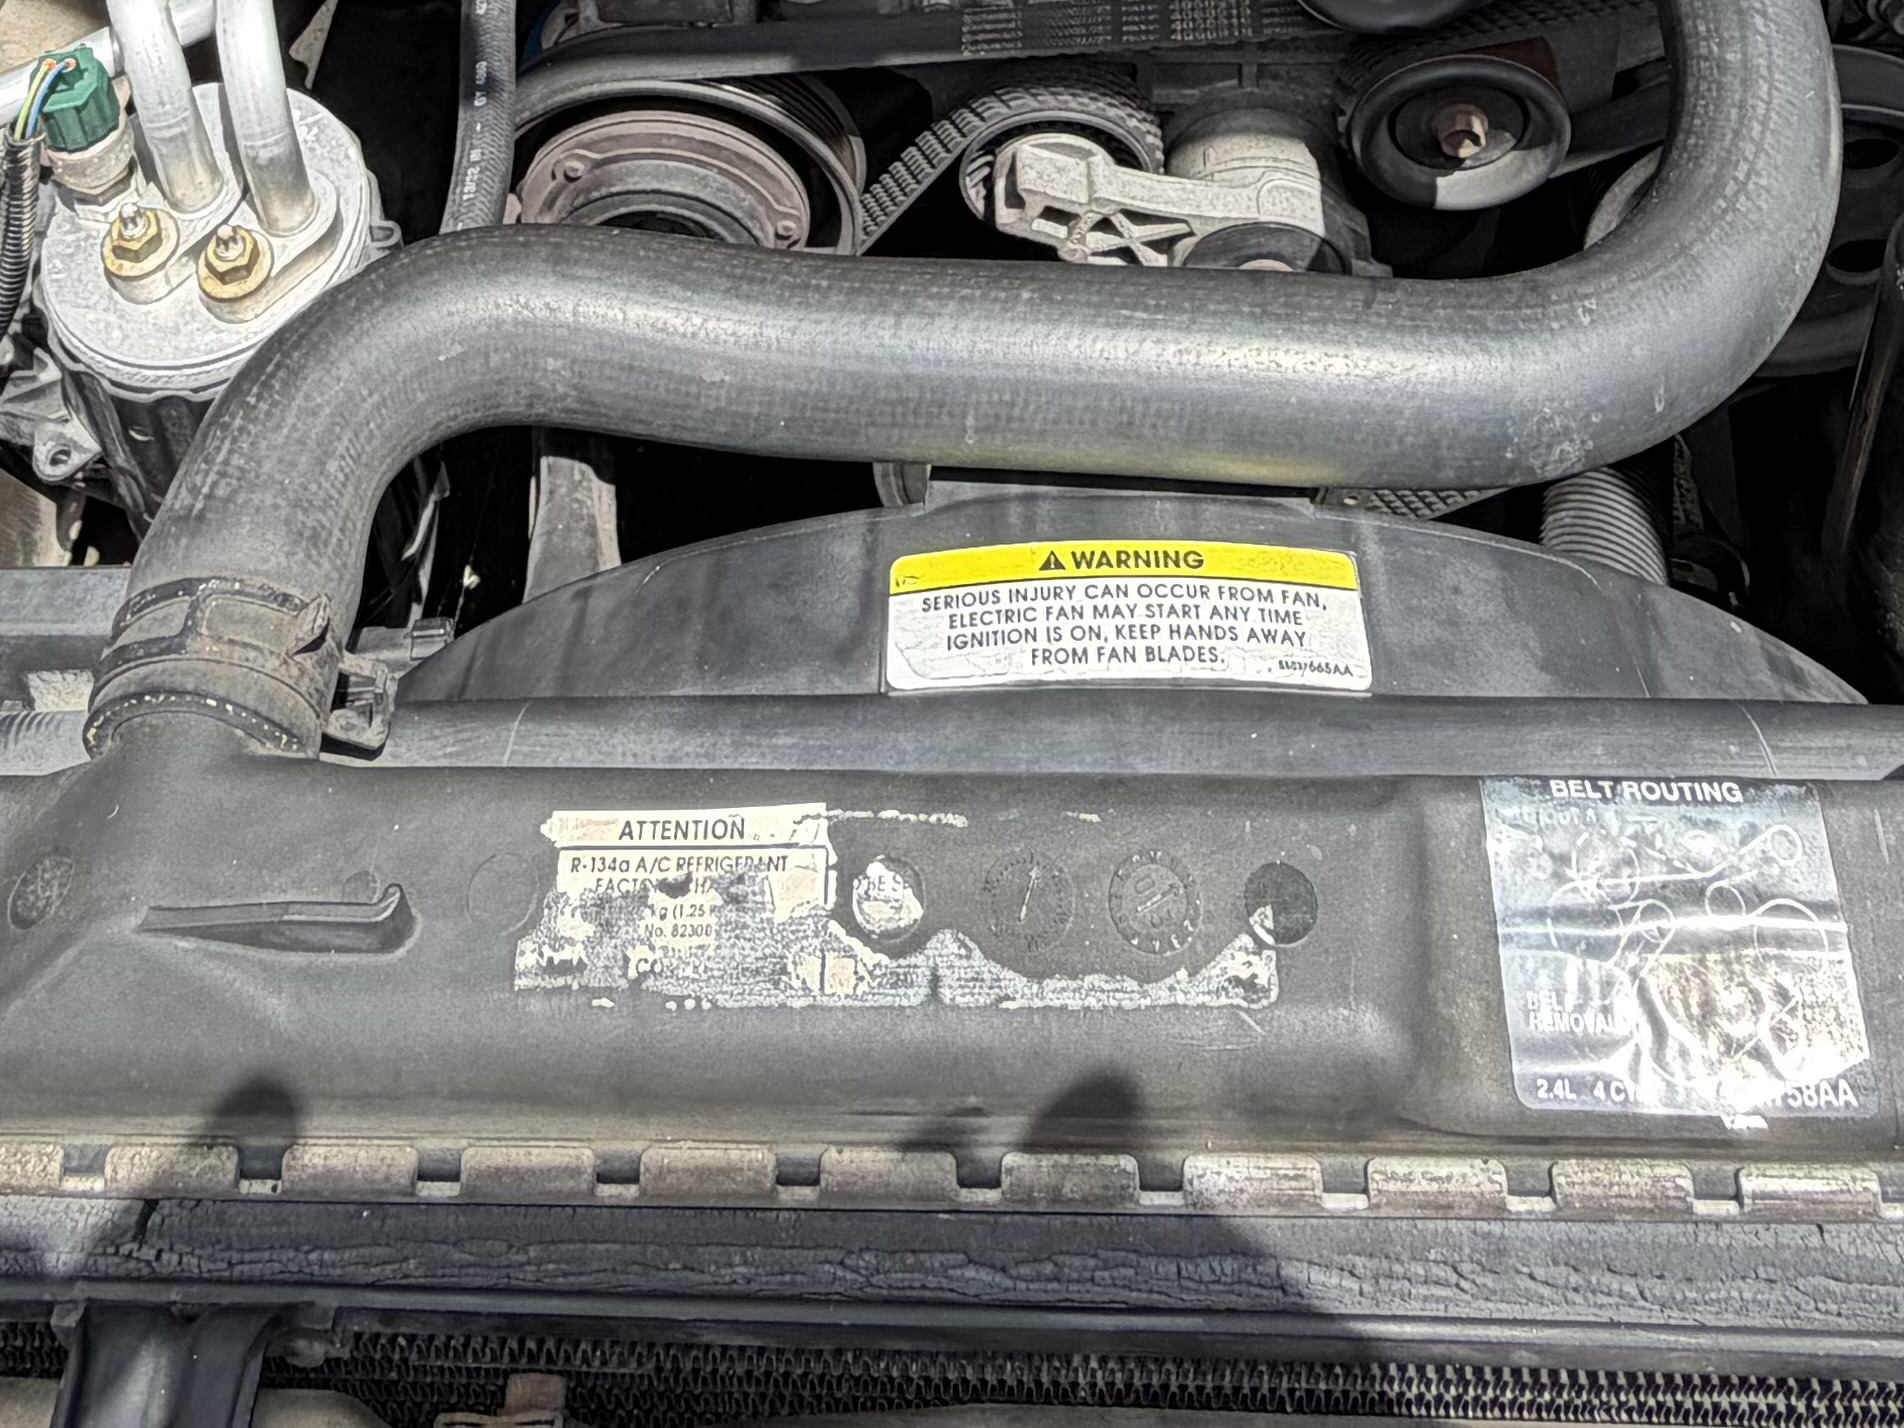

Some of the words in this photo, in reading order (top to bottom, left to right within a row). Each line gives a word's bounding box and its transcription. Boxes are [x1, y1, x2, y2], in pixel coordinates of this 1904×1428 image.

[1071, 549, 1206, 571] WARNING
[922, 588, 1002, 613] SERIOUS
[1008, 585, 1078, 603] INJURY
[1084, 584, 1131, 601] CAN
[1137, 583, 1211, 601] OCCUR
[1218, 585, 1276, 605] FROM
[949, 607, 1039, 630] ELECTRIC
[1045, 605, 1085, 622] FAN
[1092, 602, 1138, 621] MAY
[1145, 601, 1203, 621] START
[1210, 603, 1251, 623] ANY
[1258, 607, 1304, 627] TIME
[947, 627, 1039, 651] IGNITION
[1046, 626, 1064, 644] IS
[1115, 623, 1162, 643] KEEP
[1168, 623, 1240, 643] HANDS
[1246, 627, 1307, 648] AWAY
[1031, 645, 1090, 665] FROM
[1097, 644, 1138, 663] FAN
[1145, 644, 1226, 665] BLADES.
[1550, 780, 1613, 799] BELT
[1621, 781, 1744, 803] ROUTING
[619, 816, 746, 840] ATTENTION
[571, 857, 630, 874] R-134a
[636, 856, 670, 874] A/C
[644, 923, 666, 938] No.
[1537, 1080, 1577, 1099] 2.4L
[1593, 1080, 1605, 1100] 4
